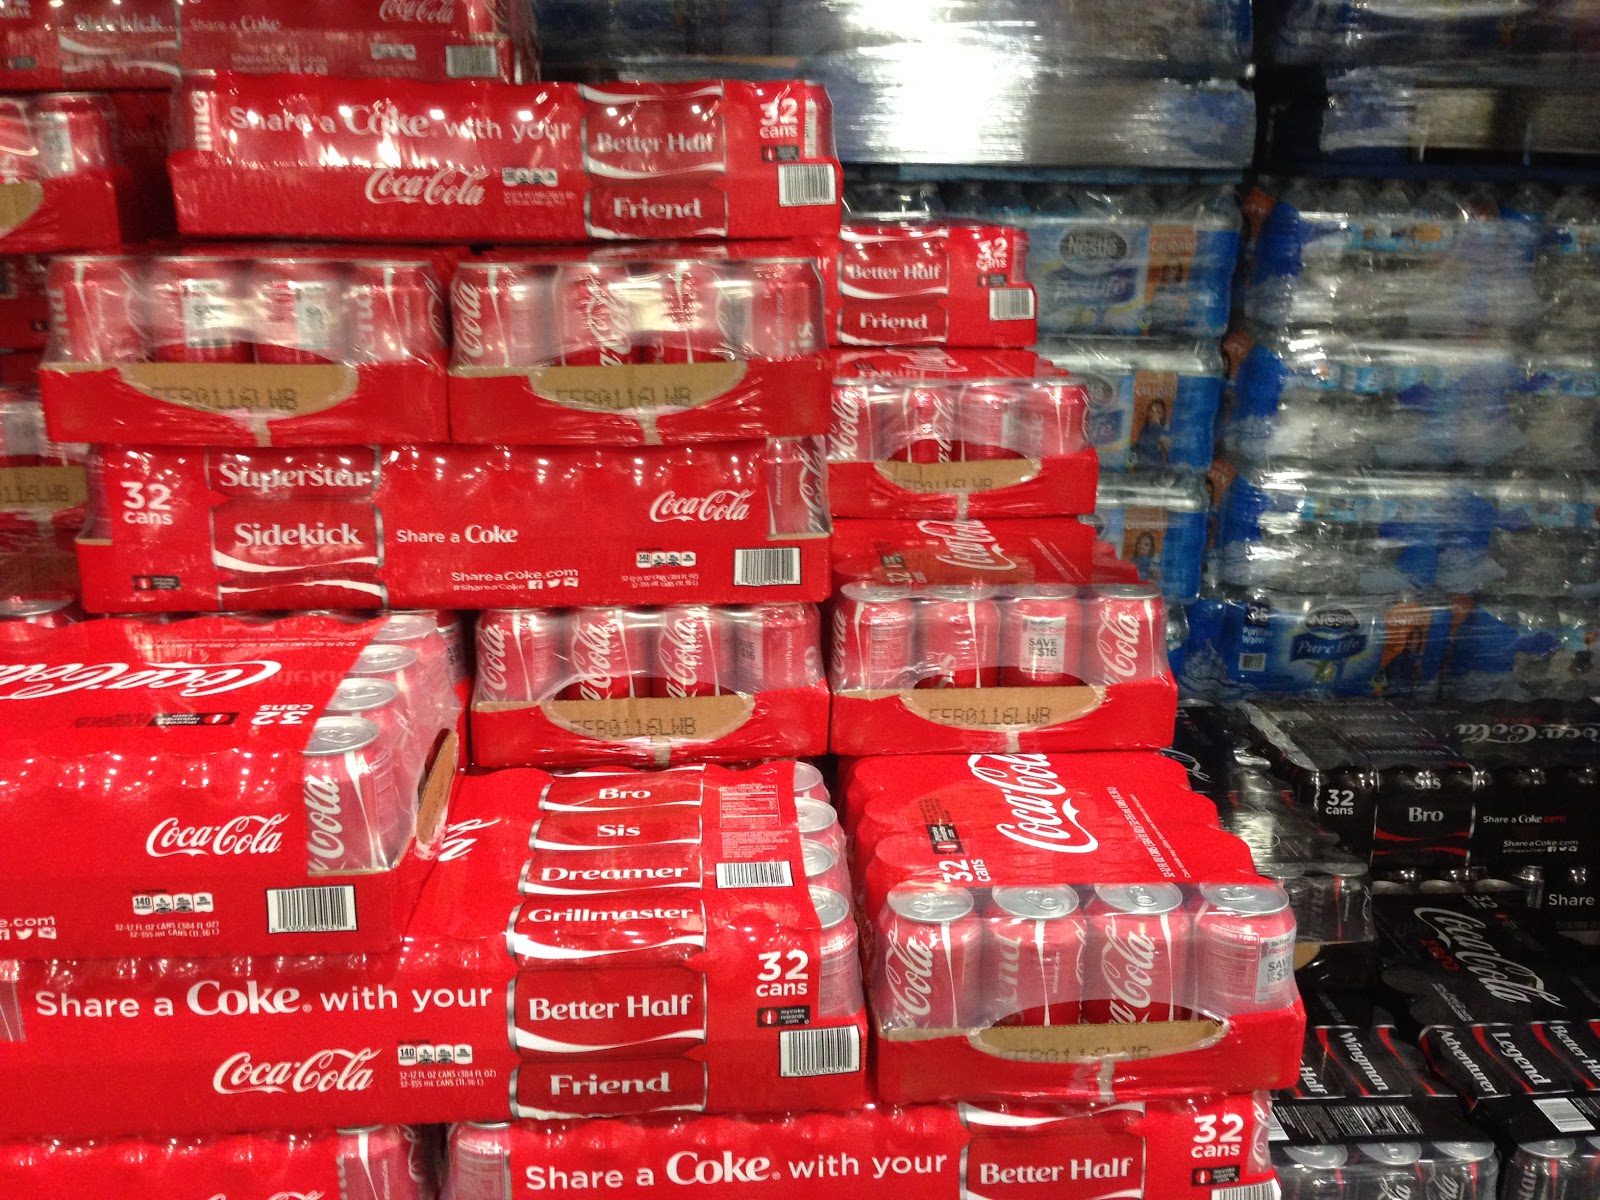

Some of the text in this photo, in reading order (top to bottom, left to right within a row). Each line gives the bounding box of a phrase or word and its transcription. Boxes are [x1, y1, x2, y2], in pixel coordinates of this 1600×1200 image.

[240, 15, 281, 32] Coke
[760, 97, 799, 126] 32
[230, 106, 309, 132] Share
[319, 117, 336, 133] a
[344, 103, 429, 136] Coke
[443, 116, 501, 139] with
[512, 119, 572, 144] your
[760, 125, 798, 138] cans
[597, 131, 716, 153] Better Half
[365, 167, 486, 206] Coca-Cola
[613, 197, 703, 220] Friend
[976, 236, 1009, 260] 32
[848, 263, 942, 281] Better Half
[859, 313, 928, 331] Friend
[220, 463, 371, 493] Superstar
[122, 481, 172, 510] 32
[649, 488, 756, 523] Coca-Cola
[123, 511, 174, 526] cans
[234, 522, 363, 548] Sidekick
[396, 525, 519, 544] Share a Coke
[451, 568, 579, 582] ShareaCoke.com
[1028, 637, 1058, 647] SAVE
[1037, 647, 1058, 657] $16
[259, 703, 314, 711] cans
[251, 710, 310, 725] 32
[1414, 774, 1442, 790] Sis
[598, 787, 652, 801] Bro
[1327, 789, 1355, 806] 32
[1325, 805, 1354, 815] cans
[1408, 807, 1444, 822] Bro
[1483, 815, 1509, 823] Share
[1518, 814, 1543, 824] Coke
[146, 813, 290, 858] Coca-Cola
[597, 823, 641, 837] Sis
[541, 866, 689, 881] Dreamer
[938, 859, 974, 884] 32
[970, 858, 992, 883] cans
[135, 897, 151, 906] 140
[1548, 893, 1596, 906] Share
[527, 907, 694, 924] Grillmaster
[757, 949, 809, 982] 32
[1413, 906, 1568, 1008] Coca-Cola
[35, 980, 493, 1018] Share a Coke with your
[756, 982, 808, 997] cans
[529, 994, 693, 1021] Better Half
[400, 1048, 415, 1057] 140
[1338, 1032, 1390, 1092] Wingman
[1437, 1030, 1498, 1094] Adventurer
[1491, 1032, 1552, 1086] Legend
[1549, 1025, 1600, 1081] Better Ha
[213, 1048, 382, 1094] Coca-Cola
[438, 1069, 456, 1079] CANS
[436, 1079, 454, 1087] CANS
[550, 1072, 671, 1097] Friend
[1300, 1067, 1329, 1096] Half
[1192, 1113, 1245, 1143] 32
[1191, 1143, 1241, 1159] cans
[525, 1151, 948, 1191] Share a Coke with your
[980, 1156, 1134, 1186] Better Half
